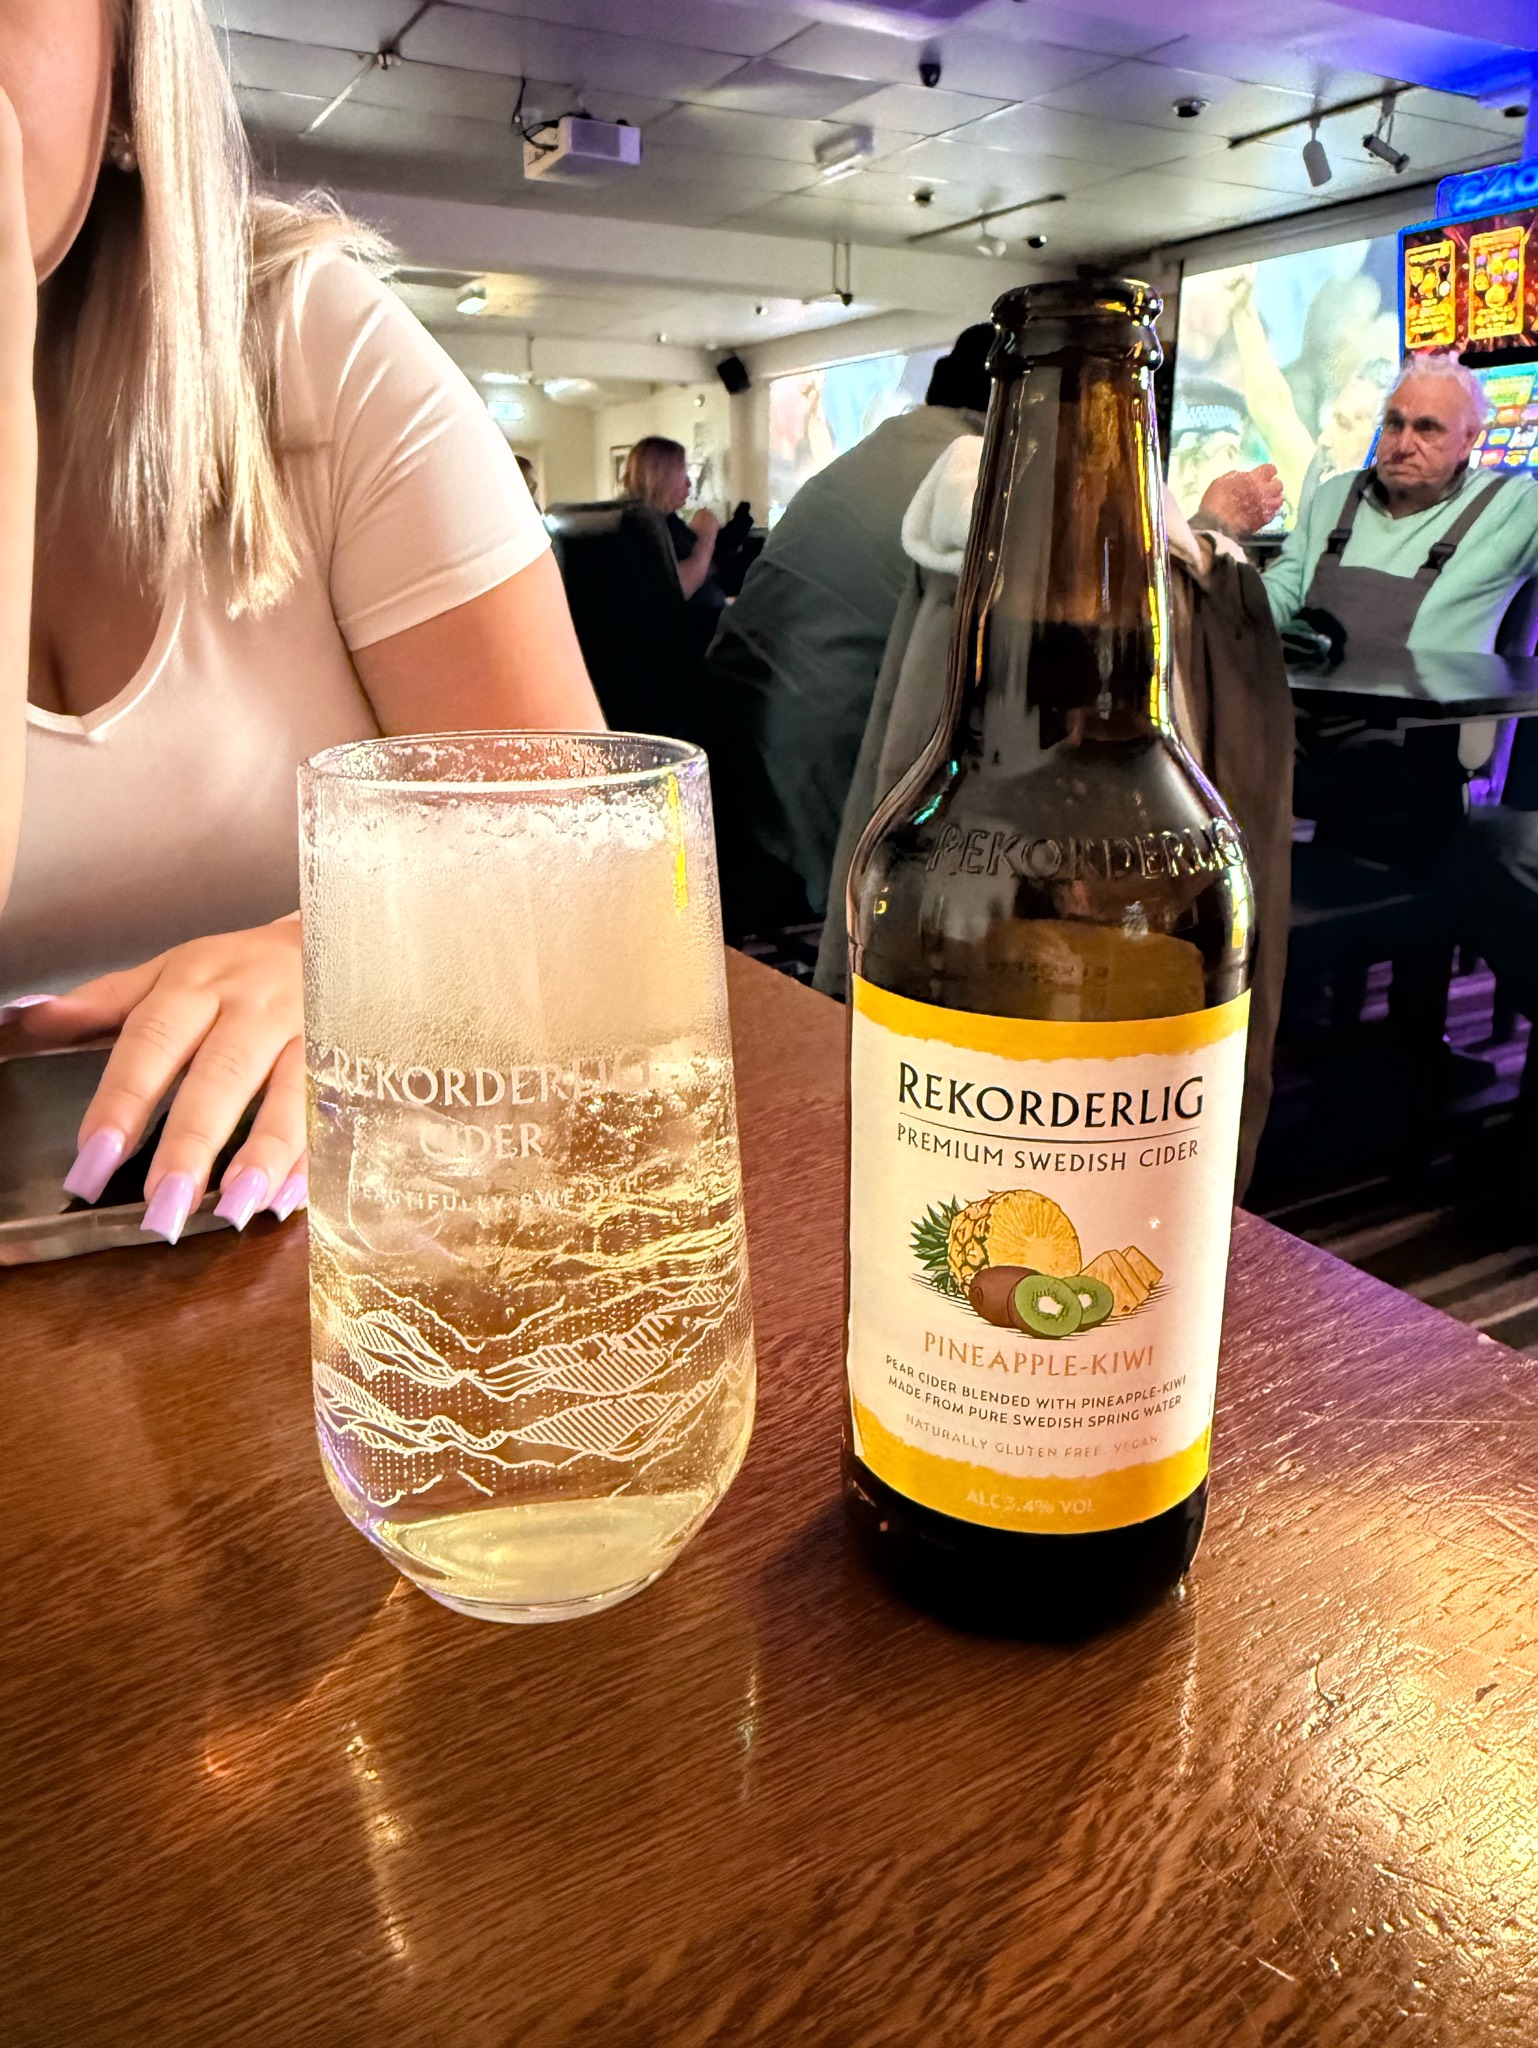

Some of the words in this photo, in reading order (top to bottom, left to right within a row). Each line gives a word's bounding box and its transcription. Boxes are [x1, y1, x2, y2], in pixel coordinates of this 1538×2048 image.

[898, 1061, 1204, 1129] REKORDERLIG
[419, 1122, 545, 1159] CIDER
[897, 1122, 1004, 1167] PREMIUM
[1014, 1150, 1127, 1173] SWEDISH
[1138, 1138, 1199, 1168] CIDER
[924, 1331, 1155, 1377] PINEAPPLE-KIWI
[886, 1354, 915, 1378] PEAR
[918, 1371, 957, 1394] CIDER
[962, 1385, 1031, 1408] BLENDED
[1035, 1397, 1077, 1410] WITH
[1081, 1374, 1187, 1409] PINEAPPLE-KIWI
[888, 1375, 922, 1399] MADE
[925, 1392, 964, 1415] FROM
[968, 1405, 1008, 1425] PURE
[1013, 1414, 1084, 1429] SWEDISH
[1087, 1409, 1140, 1428] SPRING
[1143, 1395, 1182, 1417] WATER
[905, 1413, 989, 1450] NATURALLY
[994, 1441, 1058, 1459] GLUTEN
[965, 1488, 1001, 1510] ALC
